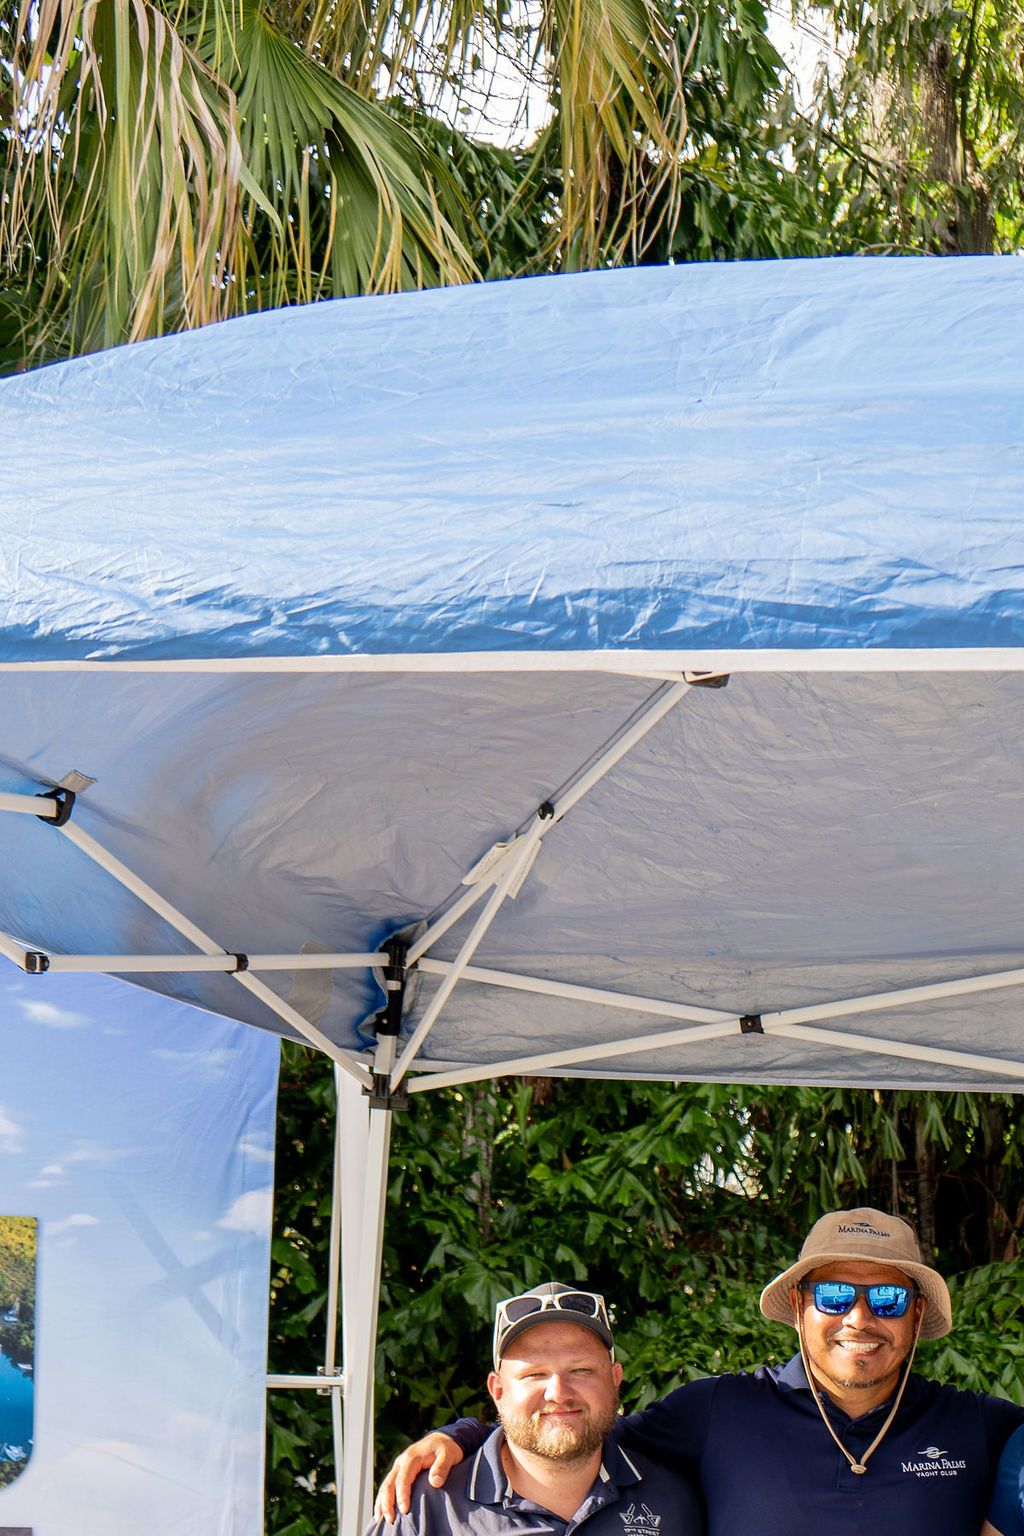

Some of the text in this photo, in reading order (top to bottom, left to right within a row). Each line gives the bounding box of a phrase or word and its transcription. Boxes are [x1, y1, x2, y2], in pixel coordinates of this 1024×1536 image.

[838, 1225, 868, 1234] MARINA
[901, 1458, 967, 1472] MARINA PALMS
